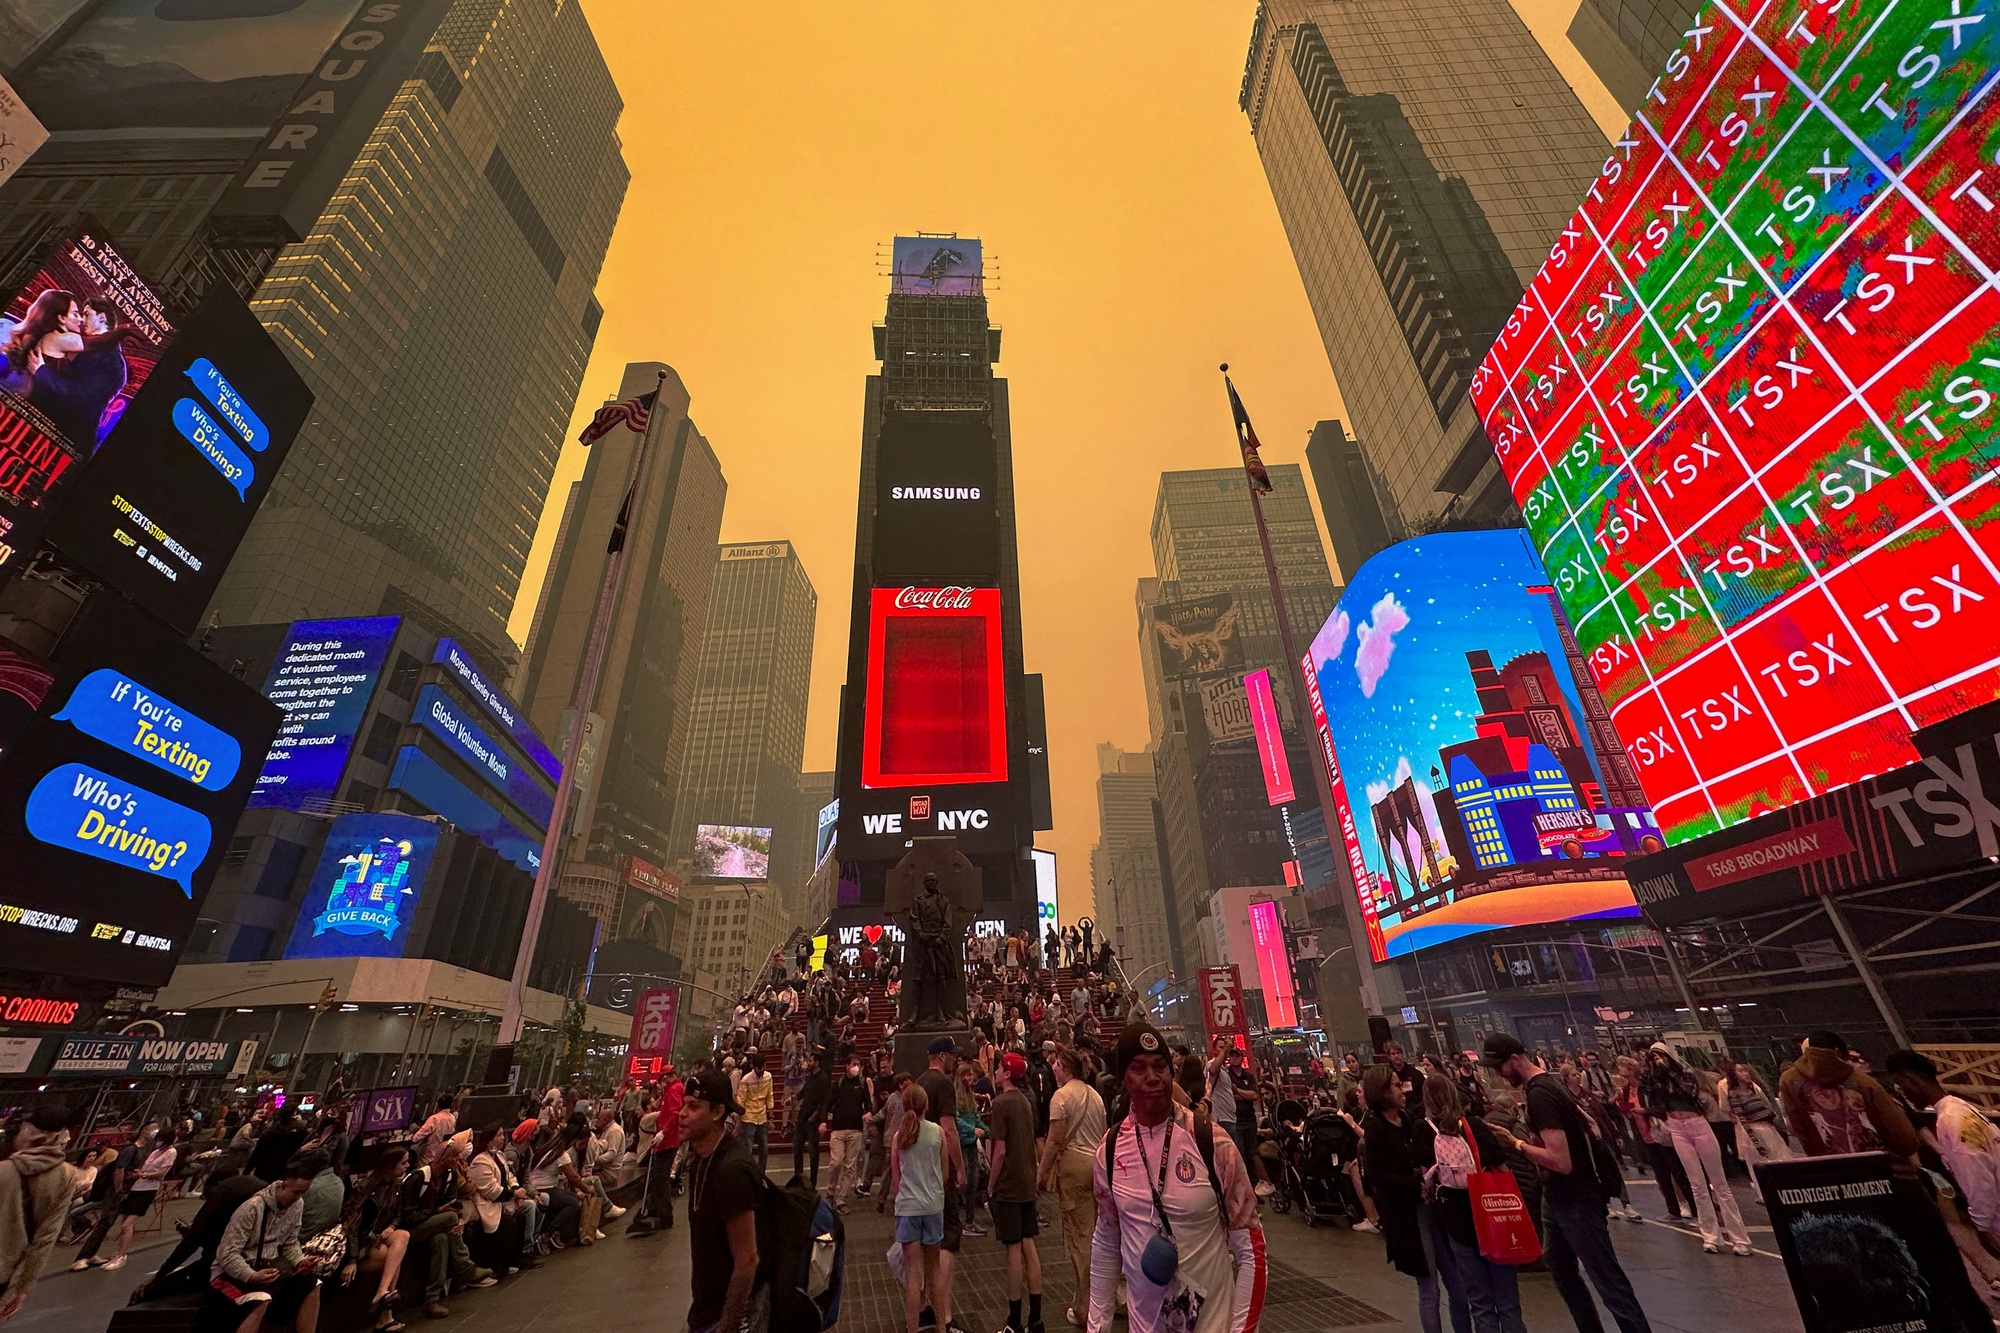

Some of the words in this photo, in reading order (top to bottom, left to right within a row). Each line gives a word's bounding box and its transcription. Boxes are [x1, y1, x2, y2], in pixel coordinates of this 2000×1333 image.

[1645, 12, 1714, 106] TSX
[1859, 0, 1986, 120] TSX
[242, 3, 402, 188] SQUARE
[1696, 75, 1776, 171] TSX
[1586, 120, 1640, 204] TSX
[1755, 147, 1850, 248] TSX
[1537, 218, 1583, 284] TSX
[1627, 189, 1690, 270] TSX
[81, 234, 96, 250] 10
[97, 249, 128, 283] TONY
[104, 242, 165, 312] WINNER!
[70, 246, 107, 287] BEST
[105, 284, 162, 346] MUSICAL!
[110, 278, 136, 306] INCLUDING
[1673, 261, 1748, 344] TSX
[1823, 235, 1937, 337] TSX
[1496, 287, 1535, 352] TSX
[1571, 280, 1623, 349] TSX
[207, 367, 218, 381] If
[216, 376, 242, 409] You're
[1524, 354, 1568, 414] TSX
[1609, 352, 1670, 421] TSX
[1728, 346, 1814, 430] TSX
[190, 406, 220, 441] Who's
[215, 392, 255, 442] Texting
[192, 427, 243, 480] Driving?
[1557, 422, 1606, 482] TSX
[1653, 431, 1722, 501] TSX
[891, 486, 981, 500] SAMSUNG
[1522, 482, 1555, 531] TSX
[1789, 444, 1893, 529] TSX
[111, 493, 203, 572] STOPTEXTSSTOPWRECKS.ORG
[727, 546, 765, 558] Allianz
[1593, 498, 1649, 558] TSX
[1553, 551, 1591, 602] TSX
[1702, 524, 1783, 595] TSX
[894, 585, 977, 610] Coca-Cola
[1170, 610, 1193, 626] Harry
[1193, 606, 1219, 621] Potter
[1633, 585, 1697, 646] TSX
[1862, 563, 1987, 645] TSX
[280, 664, 291, 675] of
[292, 663, 338, 674] volunteer
[285, 651, 333, 663] dedicated
[333, 650, 366, 660] month
[290, 642, 322, 652] During
[323, 640, 343, 650] this
[1587, 633, 1631, 683] TSX
[1759, 632, 1854, 699] TSX
[269, 689, 297, 698] come
[299, 686, 341, 698] together
[342, 685, 353, 695] to
[274, 676, 312, 687] service,
[313, 673, 367, 685] employees
[318, 698, 336, 708] the
[449, 648, 472, 680] Morgan
[469, 671, 491, 702] Stanley
[488, 692, 504, 716] Gives
[499, 705, 516, 728] Back
[1208, 675, 1245, 702] LITTLE
[110, 680, 132, 702] If
[132, 690, 183, 732] You're
[283, 724, 304, 734] with
[310, 711, 330, 720] can
[1680, 685, 1754, 742] TSX
[132, 719, 212, 783] Texting
[298, 734, 336, 746] around
[431, 700, 459, 735] Global
[457, 721, 490, 764] Volunteer
[487, 751, 508, 781] Month
[1627, 725, 1676, 773] TSX
[72, 773, 138, 816] Who's
[258, 775, 289, 785] Stanley
[1869, 743, 2000, 859] TSX
[862, 813, 902, 834] WE
[912, 805, 928, 815] WAY
[937, 808, 989, 831] NYC
[1535, 808, 1594, 832] HERSHEY'S
[76, 808, 188, 871] Driving?
[1538, 833, 1577, 845] CHOCOLATE
[1705, 860, 1737, 879] 1568
[1735, 833, 1821, 872] BROADWAY
[1349, 844, 1376, 916] INSIDE!
[327, 911, 358, 923] GIVE
[360, 911, 392, 926] BACK
[838, 926, 863, 944] WE
[4, 996, 80, 1025] CAMINOS
[639, 992, 671, 1051] tkts
[1208, 971, 1237, 1027] tkts
[61, 1043, 104, 1060] BLUE
[106, 1044, 135, 1060] FIN
[137, 1040, 185, 1060] NOW
[184, 1042, 229, 1061] OPEN
[142, 1062, 162, 1073] FOR
[162, 1063, 179, 1073] LUNC
[188, 1063, 214, 1073] DINNER
[1483, 1198, 1519, 1209] Nintendo
[1777, 1184, 1840, 1206] MIDNIGHT
[1840, 1179, 1894, 1199] MOMENT
[1493, 1215, 1508, 1223] NEW
[1508, 1214, 1523, 1222] YORK
[1905, 1319, 1928, 1332] ARTS
